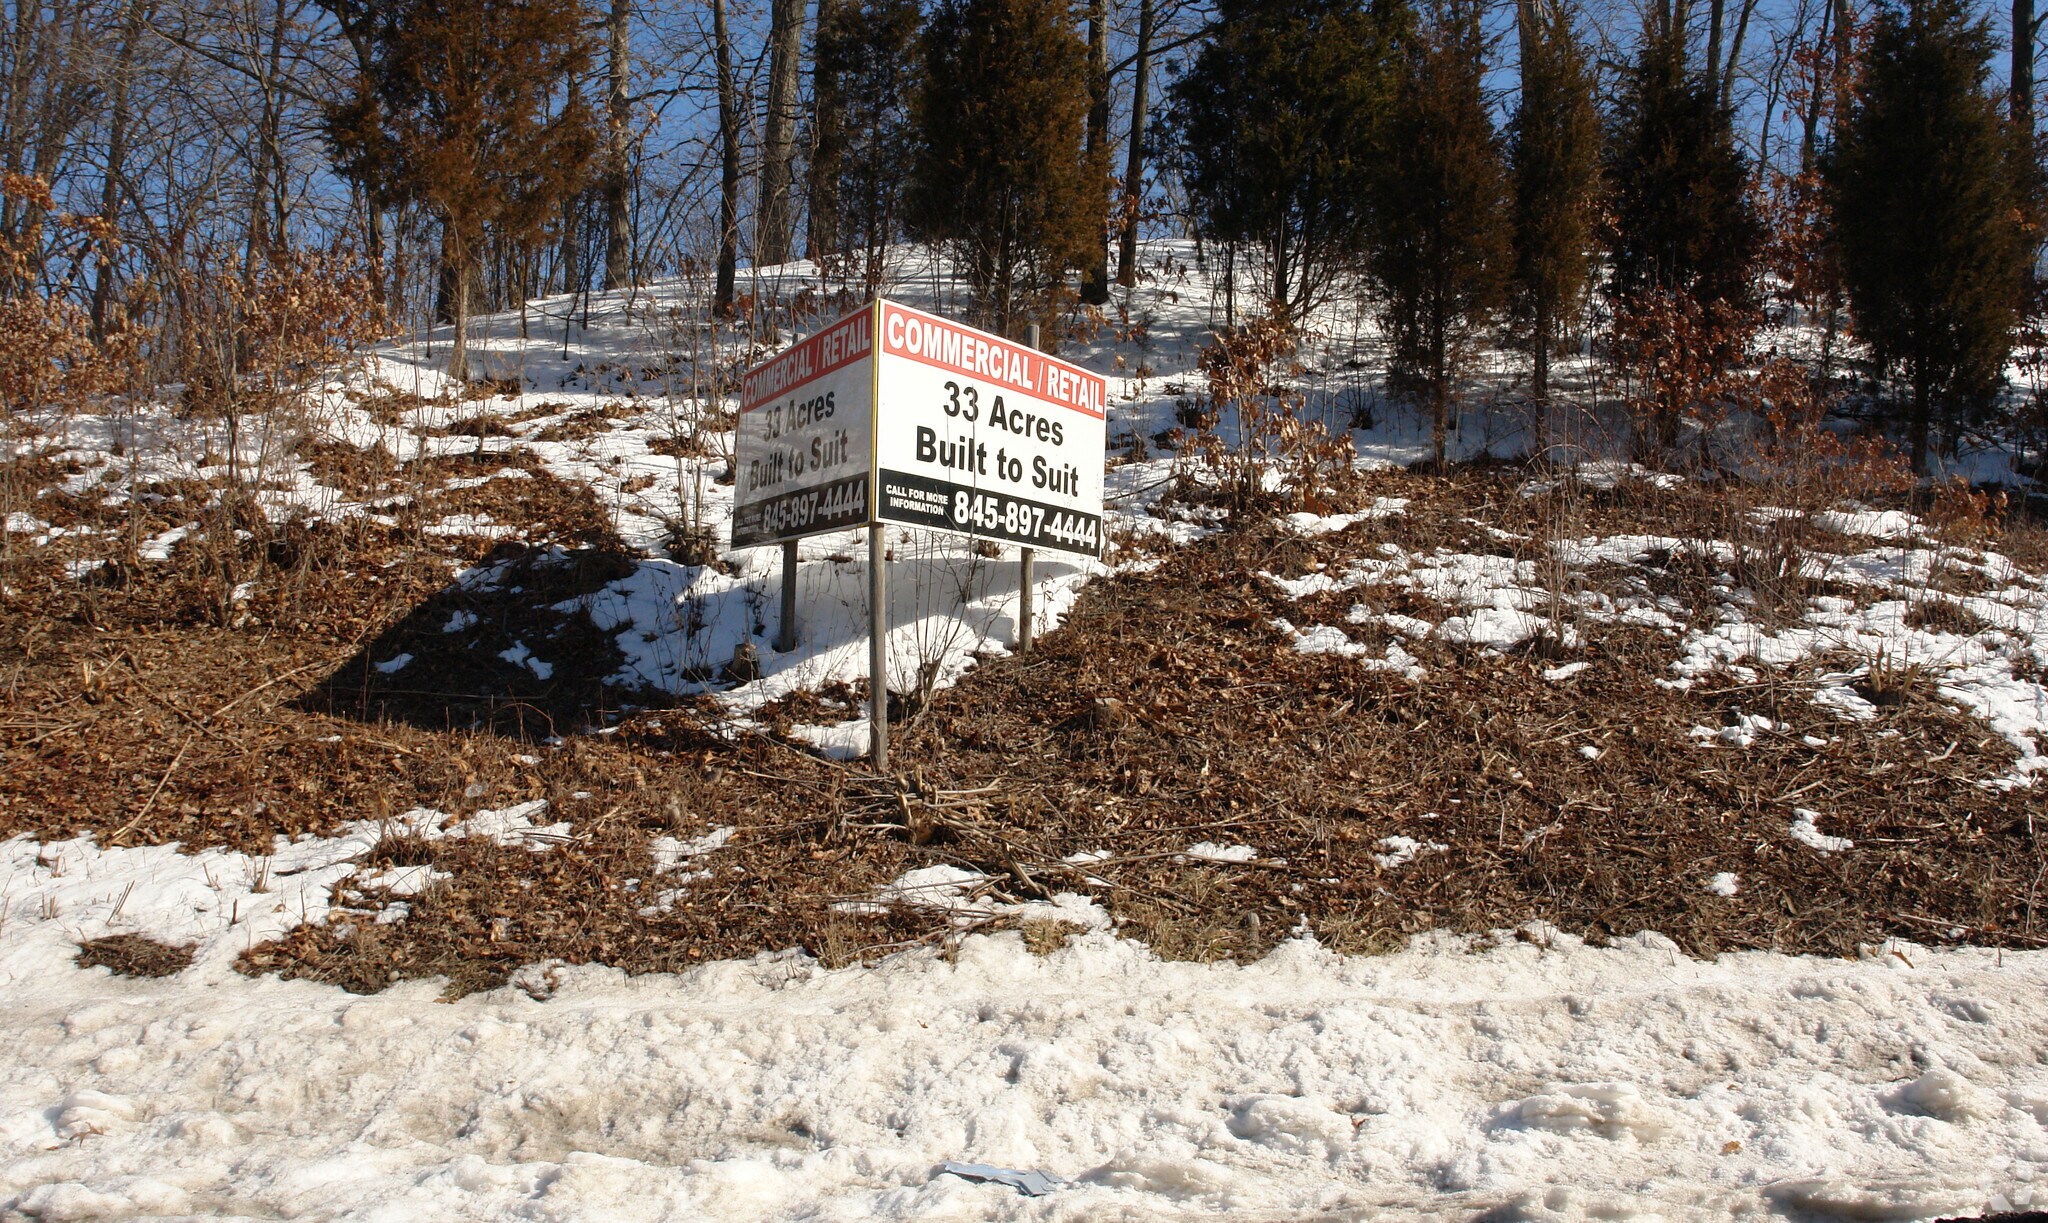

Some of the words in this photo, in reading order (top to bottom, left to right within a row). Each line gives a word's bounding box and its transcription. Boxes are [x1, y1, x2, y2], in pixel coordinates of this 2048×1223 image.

[743, 345, 812, 406] COMMERCIAL
[814, 338, 821, 374] /
[822, 315, 870, 369] RETAIL
[887, 312, 1034, 389] COMMERCIAL
[1036, 361, 1045, 393] /
[1048, 367, 1105, 414] RETAIL
[763, 405, 782, 443] 33
[785, 391, 835, 433] Acres
[943, 381, 979, 422] 33
[989, 395, 1064, 446] Acres
[749, 450, 784, 492] Built
[788, 447, 805, 479] to
[810, 427, 848, 472] Suit
[916, 425, 987, 477] Built
[997, 447, 1023, 483] to
[1032, 455, 1078, 498] Suit
[763, 479, 865, 534] 845-897-4444
[886, 484, 907, 497] CALL
[908, 488, 925, 500] FOR
[926, 491, 949, 505] MORE
[889, 496, 945, 516] INFORMATION
[953, 490, 1097, 549] 845-897-4444
